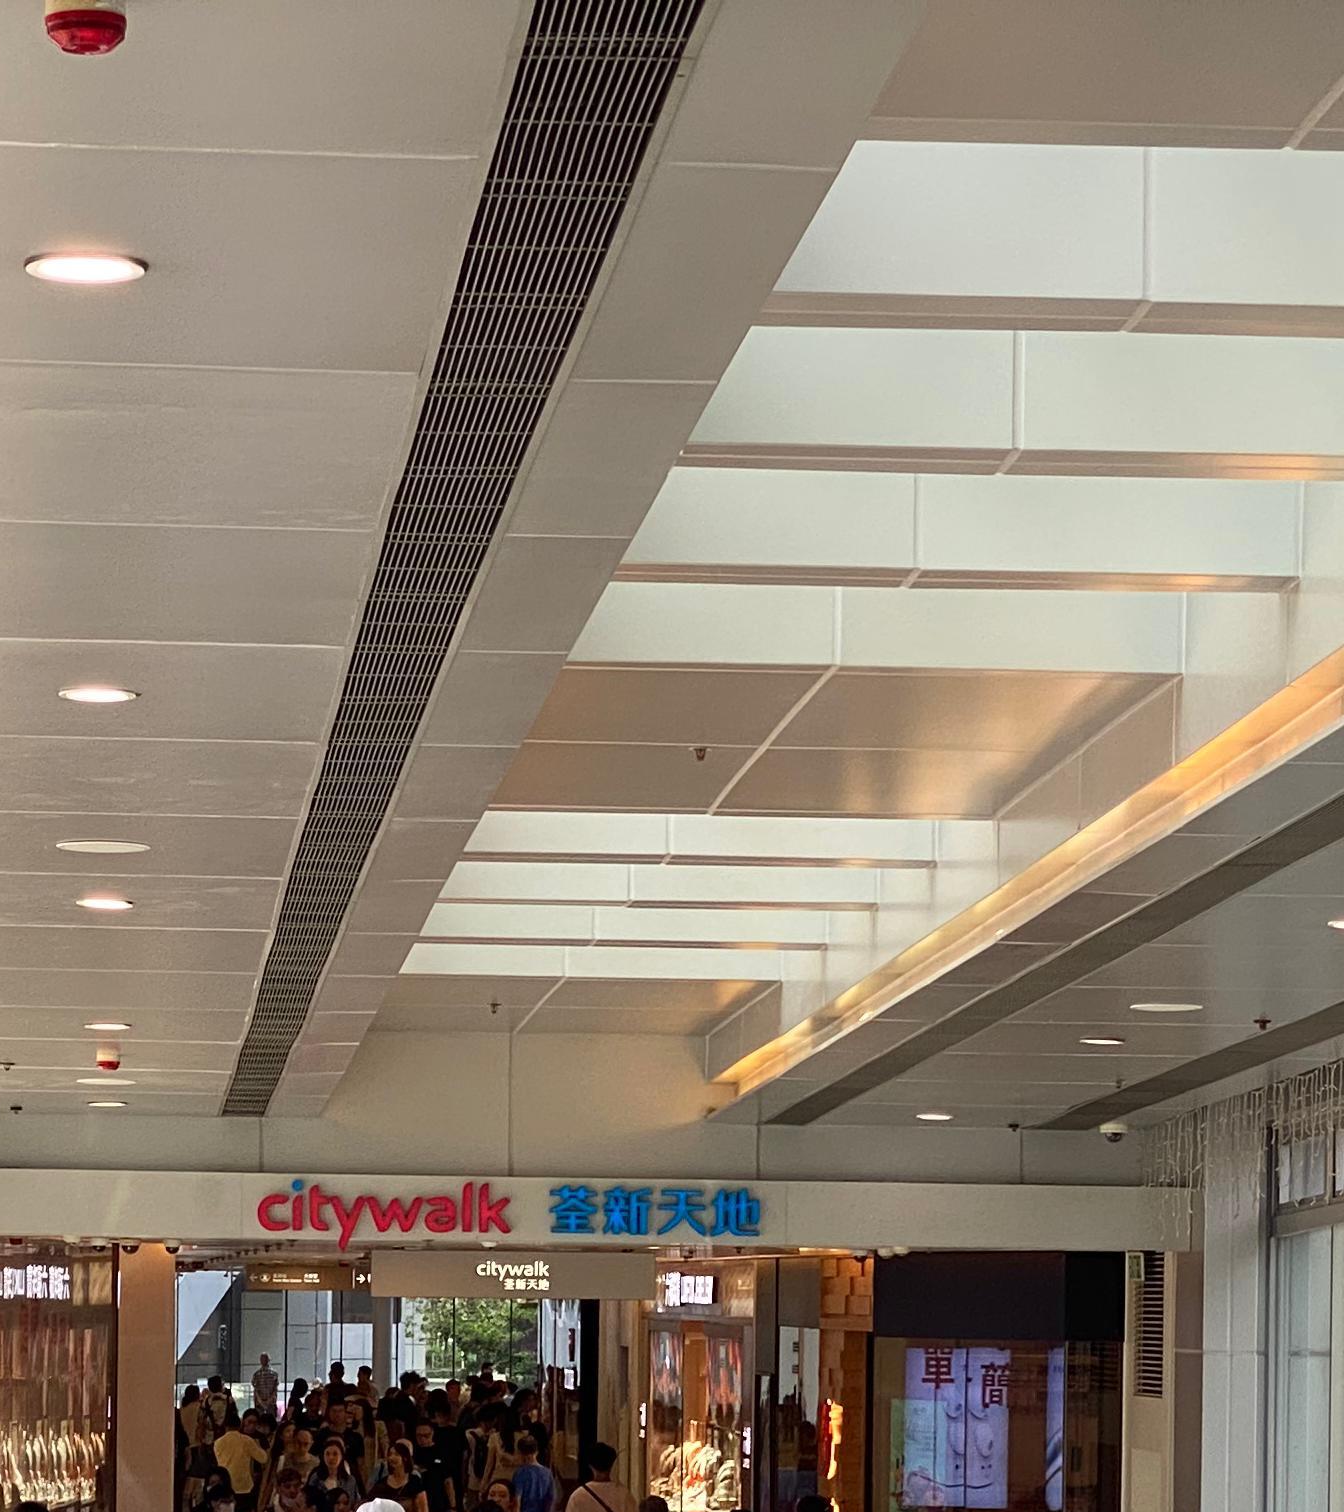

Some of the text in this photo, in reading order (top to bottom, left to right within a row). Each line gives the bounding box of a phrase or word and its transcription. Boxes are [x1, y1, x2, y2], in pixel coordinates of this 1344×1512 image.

[257, 1179, 512, 1251] citywalk
[549, 1184, 761, 1238] 荃新天地
[476, 1261, 549, 1281] citywalk
